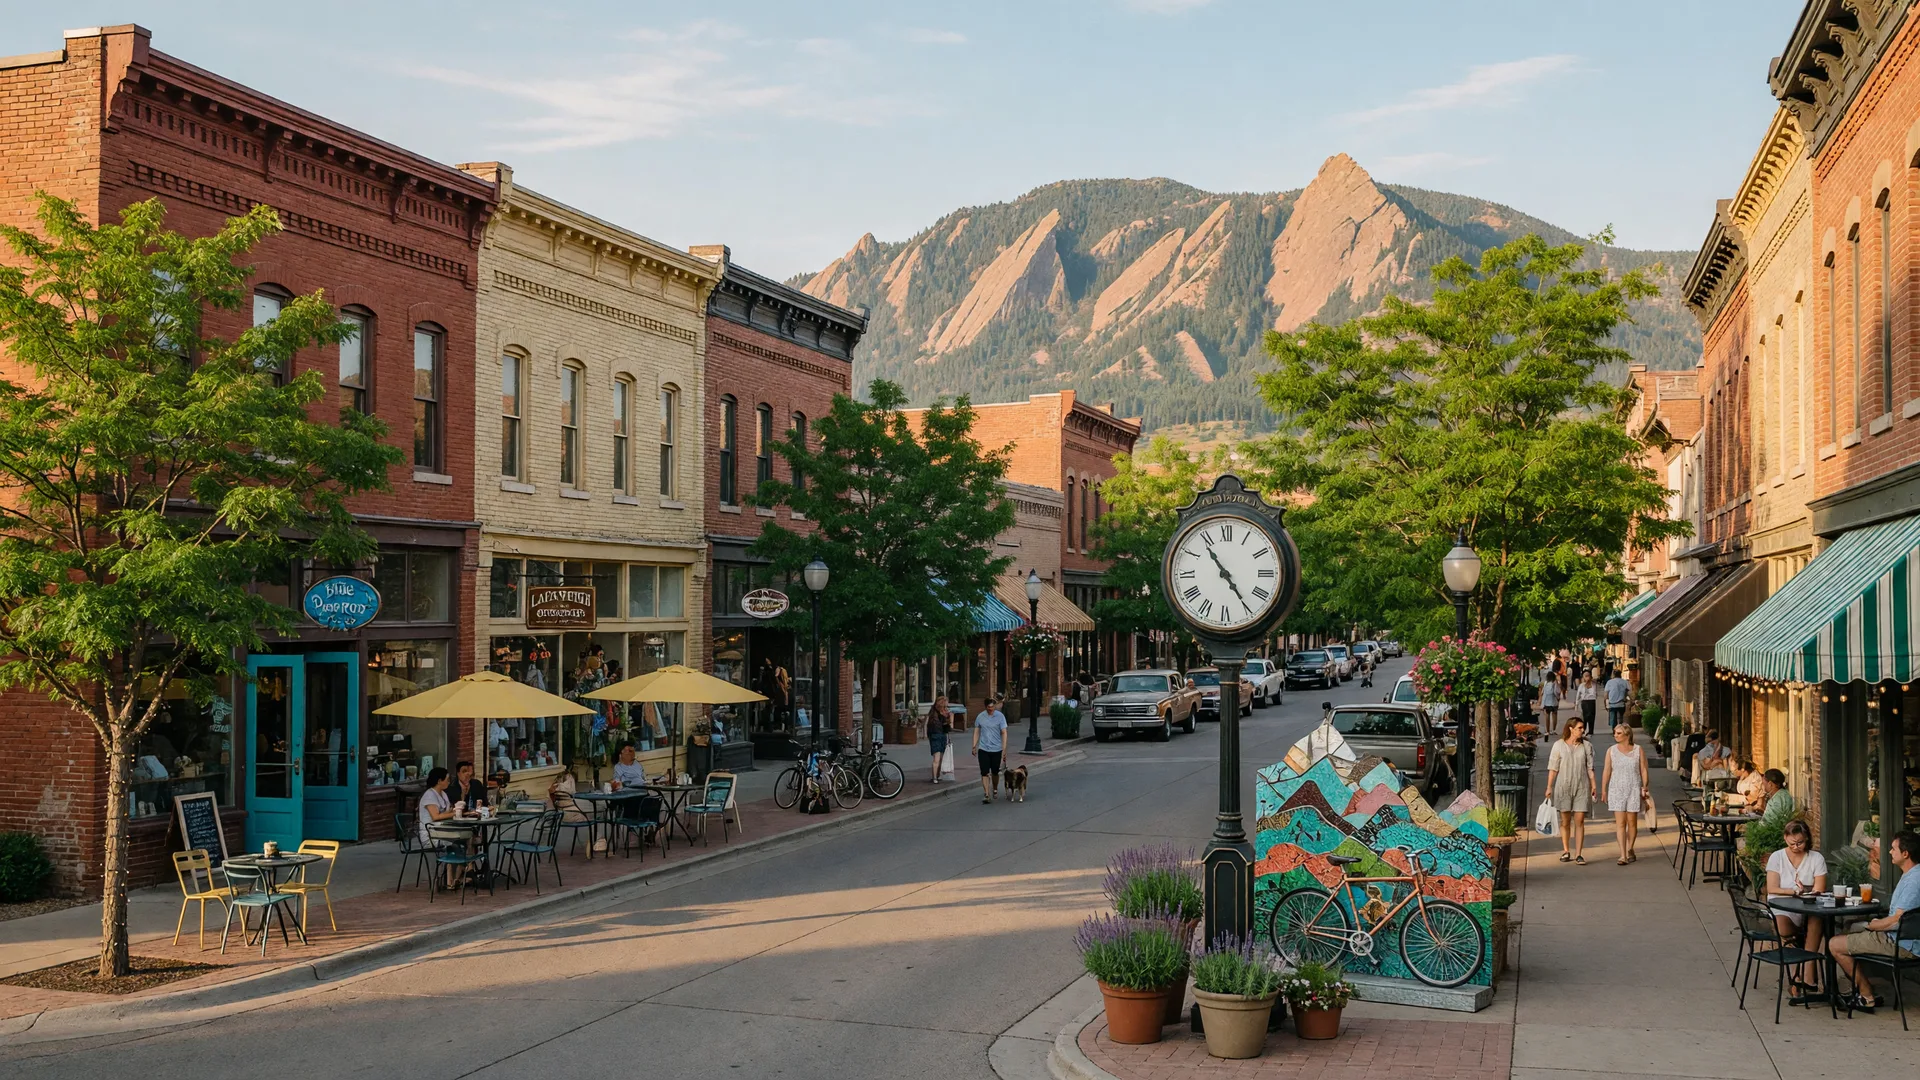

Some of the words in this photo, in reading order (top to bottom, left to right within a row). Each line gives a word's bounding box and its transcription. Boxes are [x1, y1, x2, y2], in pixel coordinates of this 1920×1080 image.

[1220, 525, 1232, 542] XII
[1241, 531, 1251, 545] I
[1252, 547, 1269, 559] II
[1258, 569, 1274, 578] III
